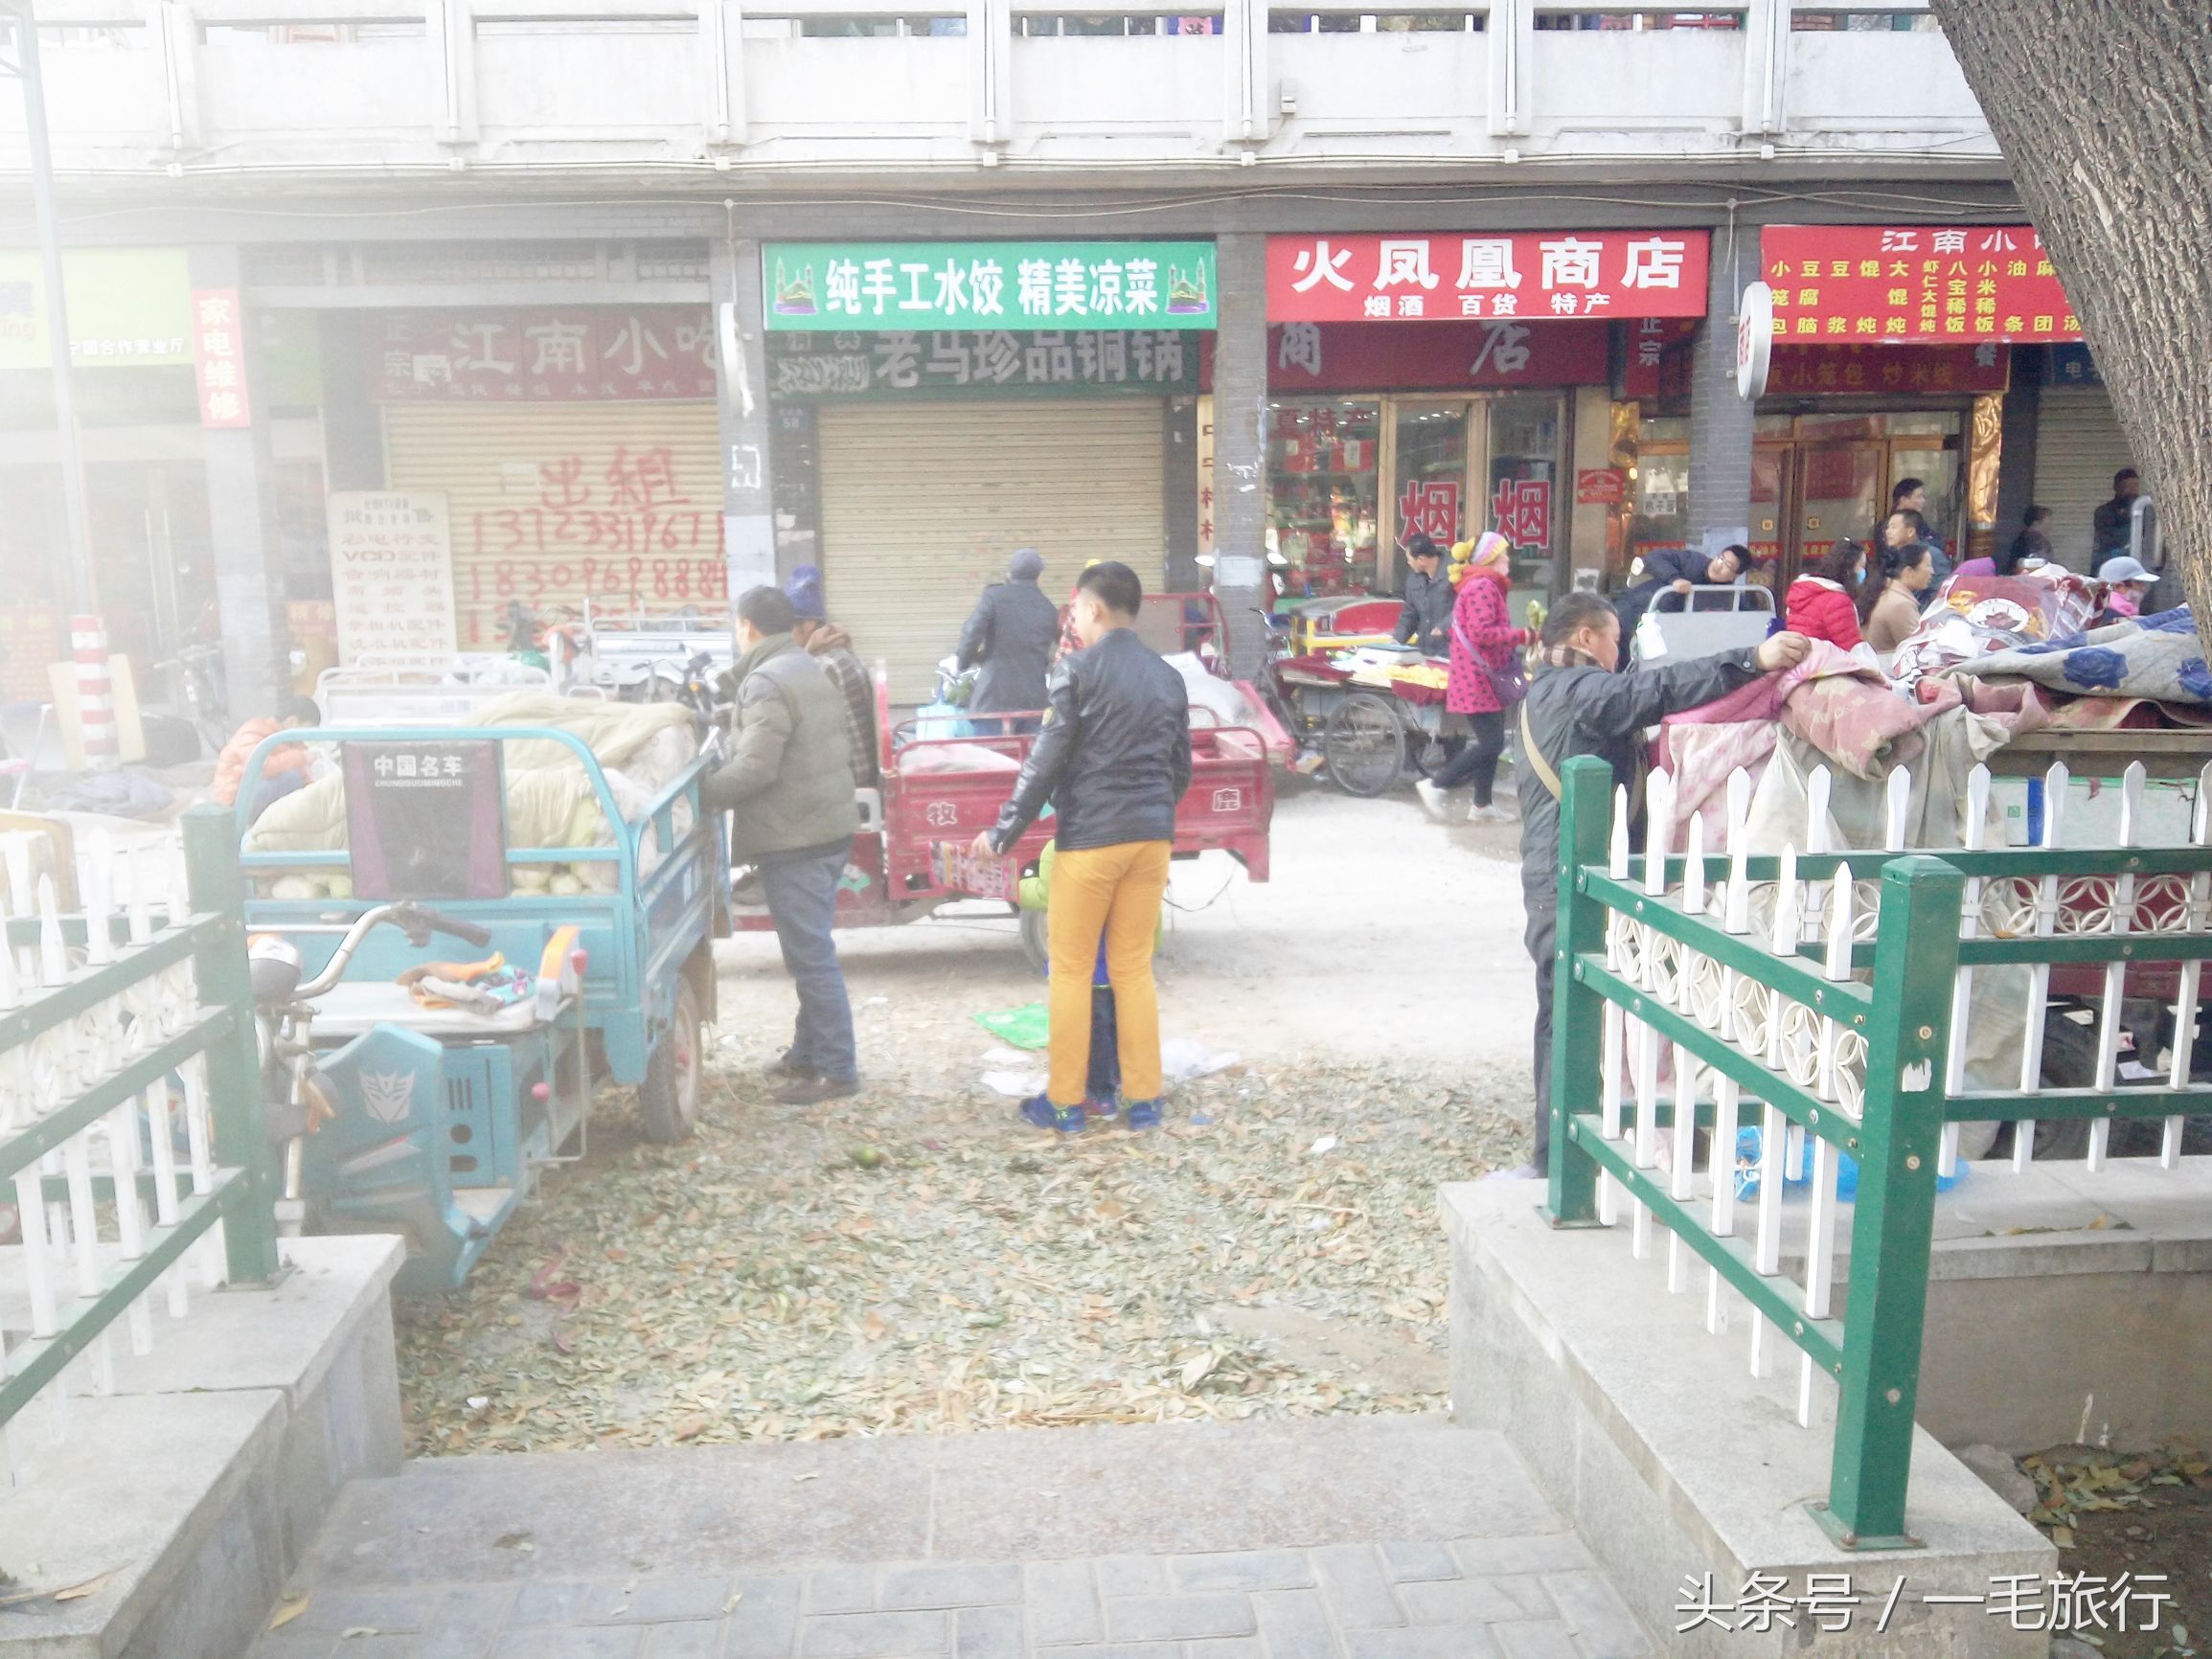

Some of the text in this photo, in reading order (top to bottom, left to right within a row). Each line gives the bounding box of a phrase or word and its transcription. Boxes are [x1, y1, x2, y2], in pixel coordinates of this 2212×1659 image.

[1290, 236, 1686, 293] 火凤凰商店
[1881, 228, 2044, 255] 江南小
[825, 258, 1158, 317] 纯手工水饺 精美凉菜
[1363, 291, 1611, 318] 烟酒 百货 特产
[1797, 260, 1820, 334] 豆腐脑
[1827, 260, 1851, 334] 豆浆
[1946, 260, 1968, 334] 八宝稀饭
[1974, 260, 1997, 334] 小米稀饭
[2004, 260, 2028, 333] 油条
[199, 298, 242, 420] 家电维修
[449, 315, 717, 376] 江南小吃
[1399, 480, 1458, 551] 烟
[1492, 479, 1550, 551] 烟
